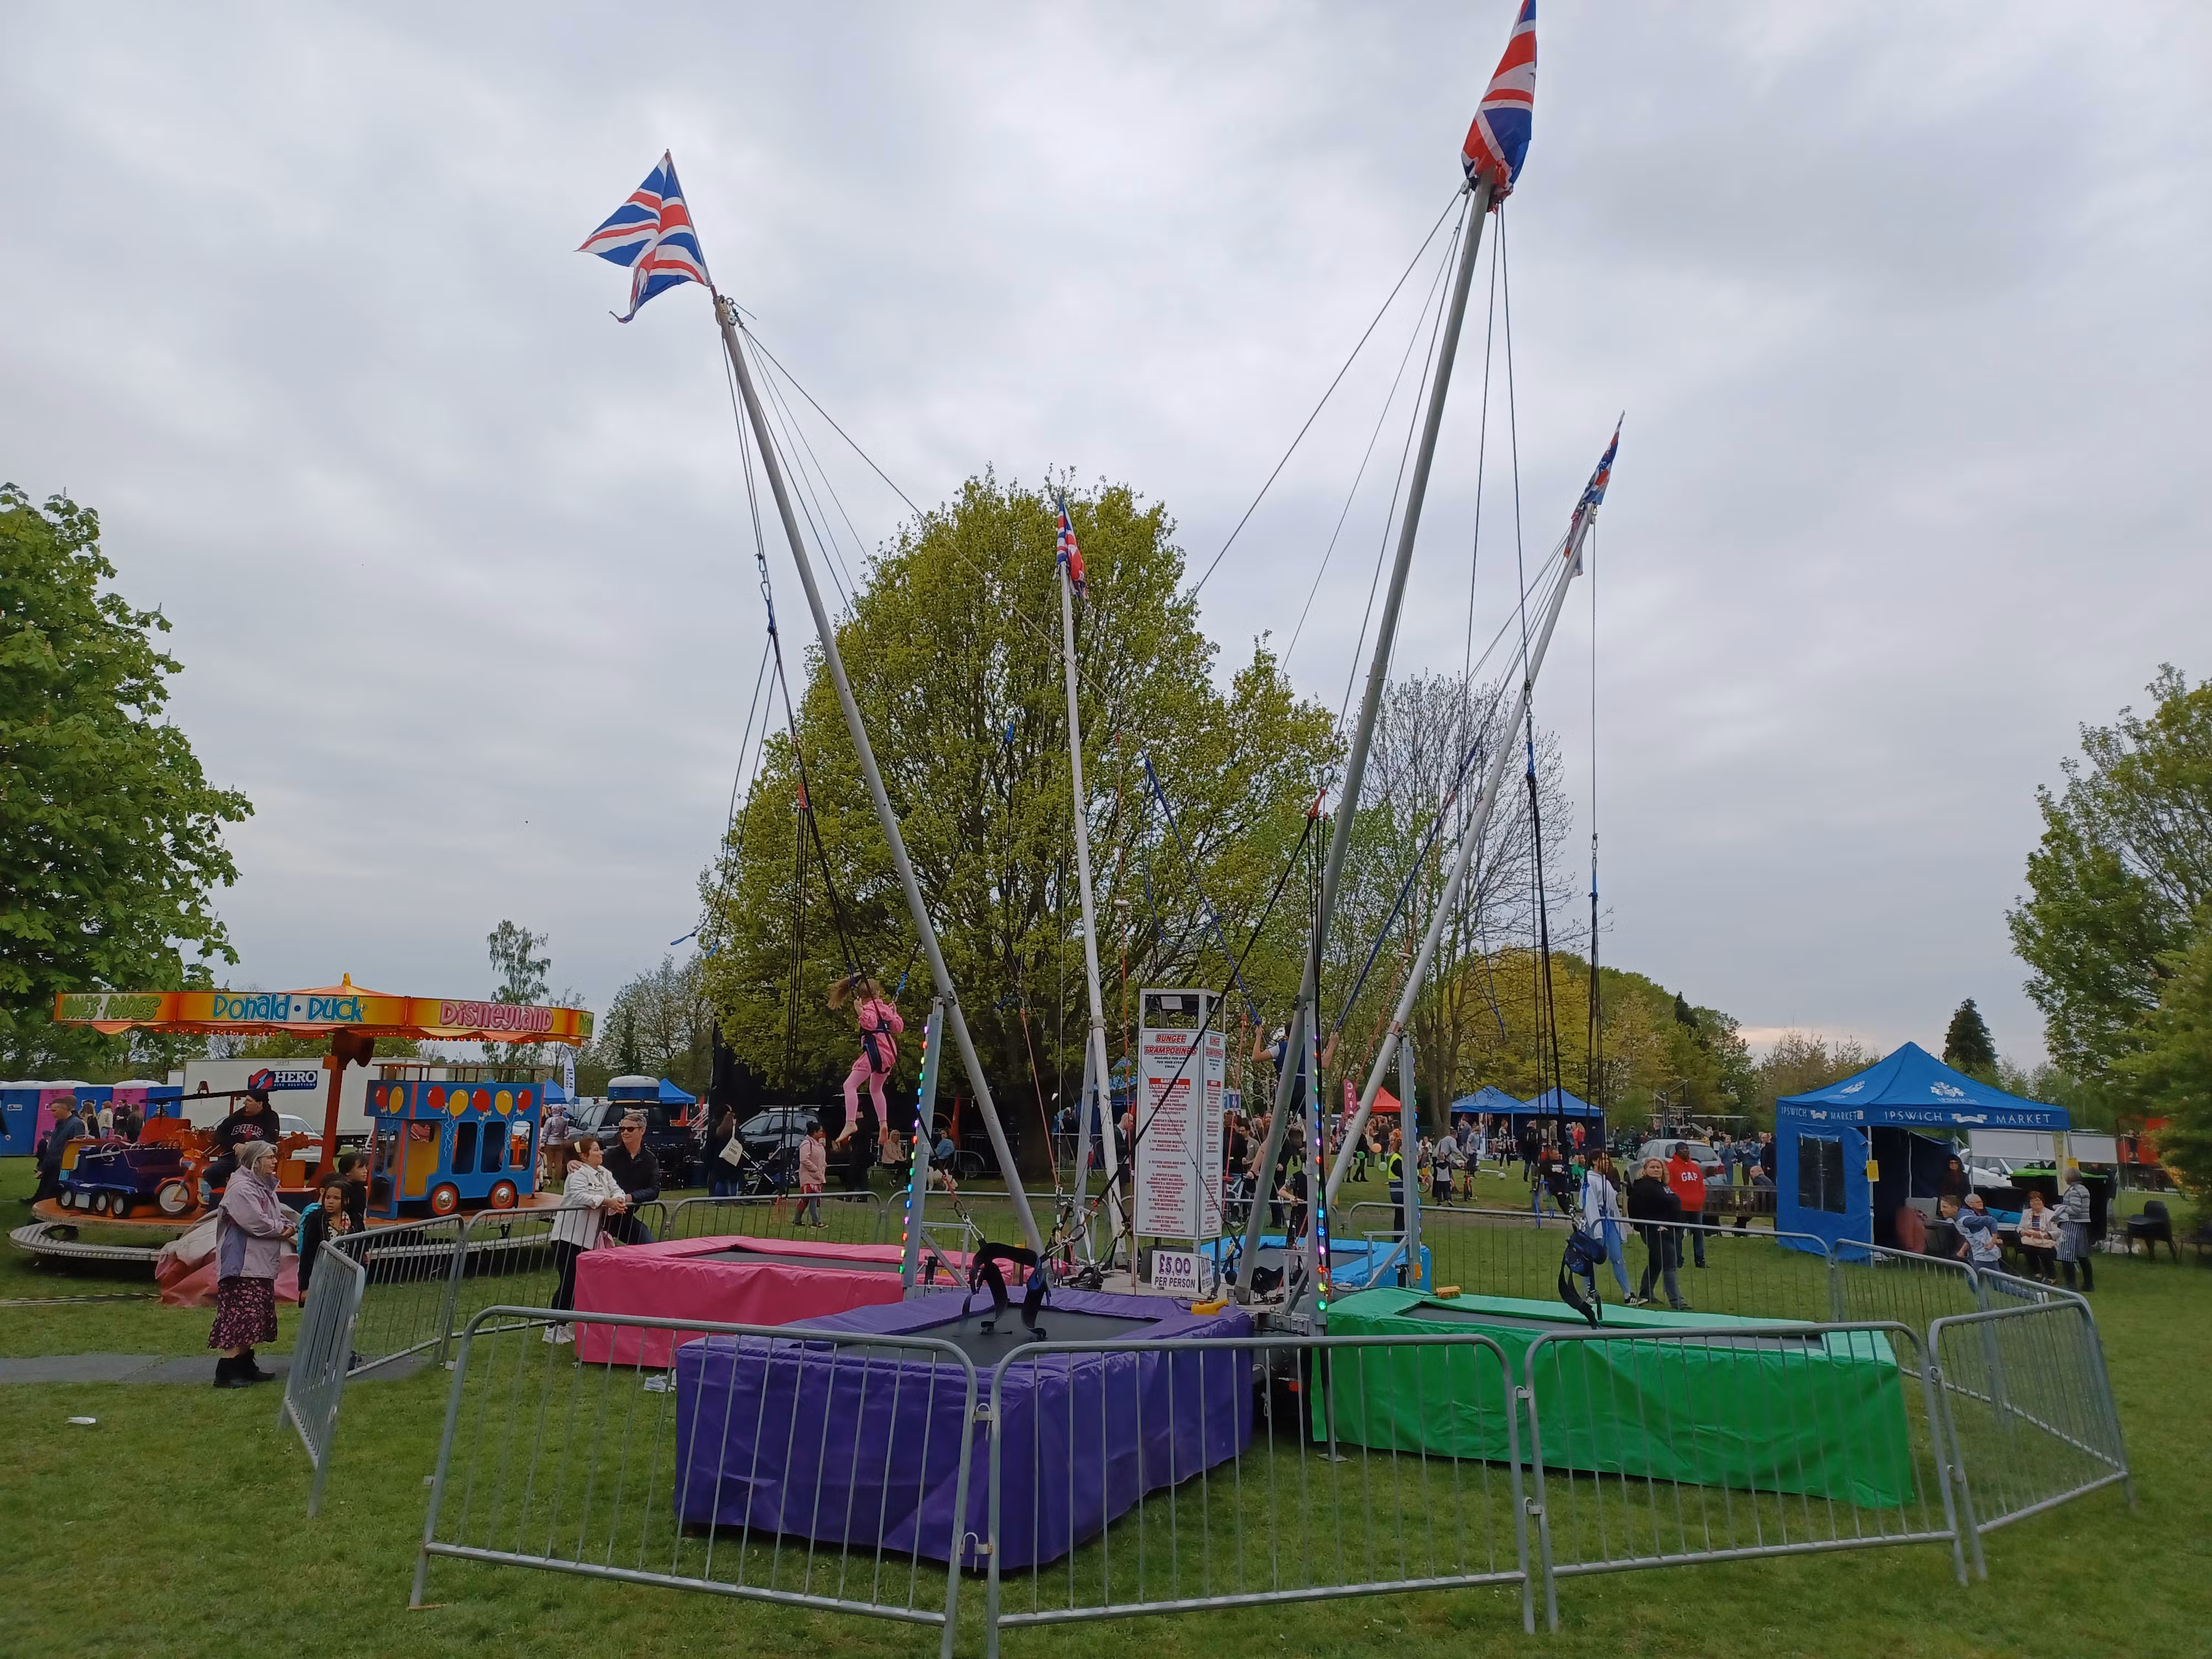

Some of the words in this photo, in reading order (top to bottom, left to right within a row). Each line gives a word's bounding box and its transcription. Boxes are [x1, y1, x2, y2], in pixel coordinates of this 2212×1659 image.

[212, 993, 293, 1021] Donald
[1155, 1034, 1187, 1044] BUNGEE
[274, 1071, 317, 1083] HERO
[1781, 1107, 1807, 1118] IPSWICH
[1831, 1112, 1858, 1121] MARKET
[1885, 1111, 1943, 1122] IPSWICH
[1996, 1114, 2051, 1124] MARKET
[1681, 1171, 1698, 1182] GAP
[1154, 1276, 1167, 1286] PER
[1169, 1277, 1195, 1288] PERSON
